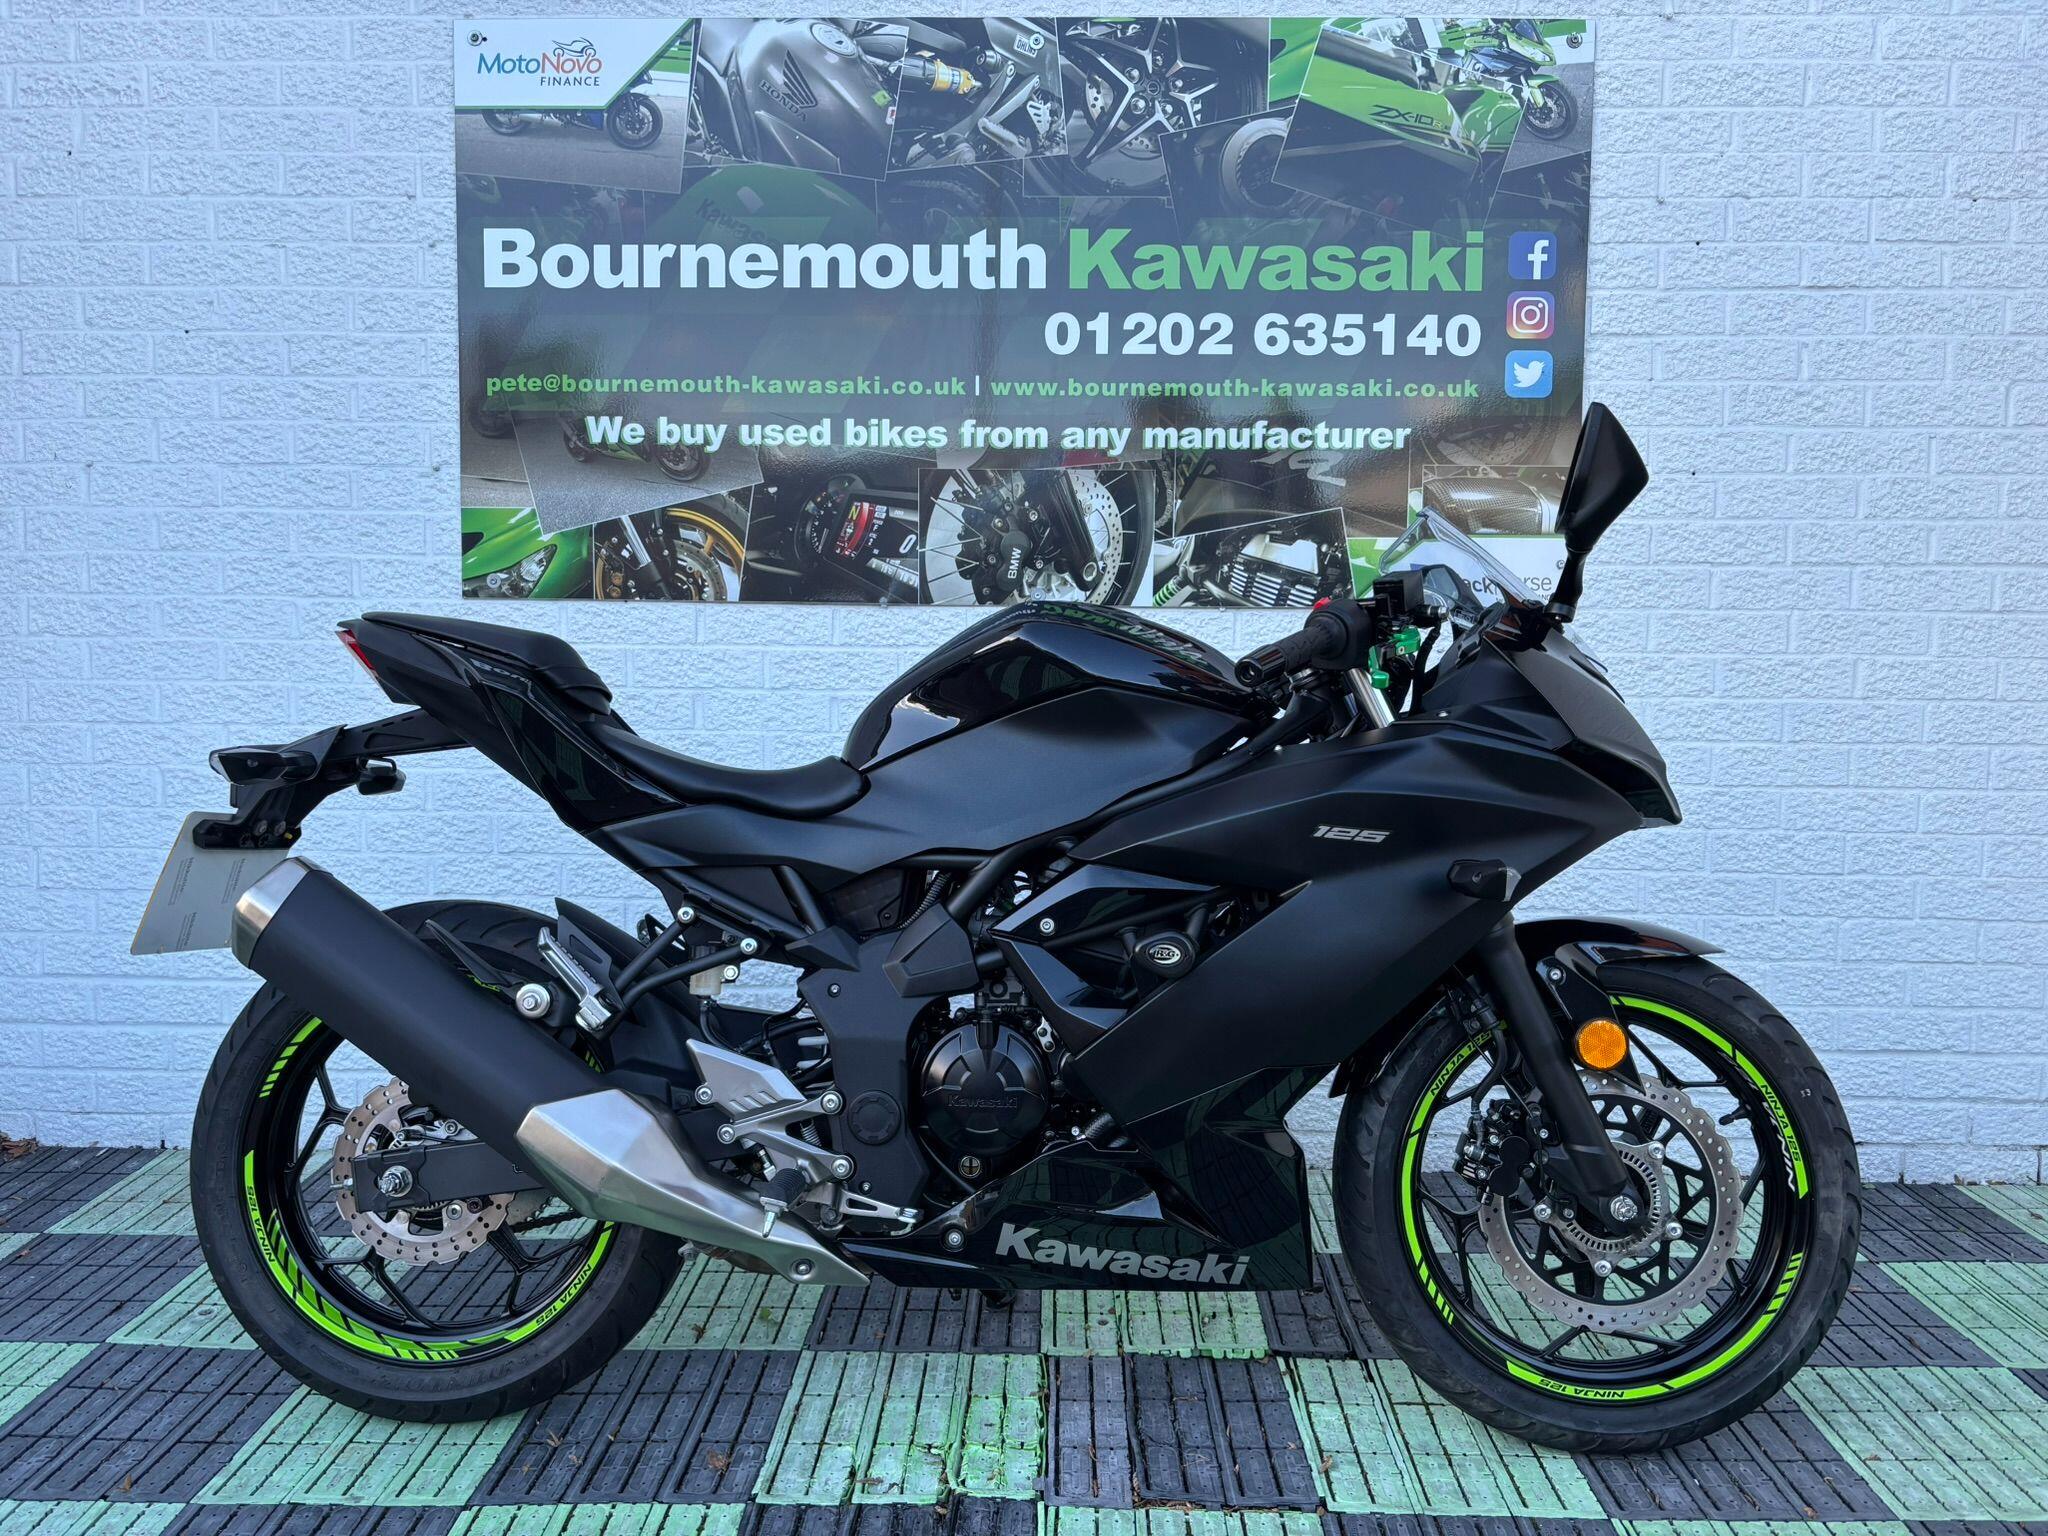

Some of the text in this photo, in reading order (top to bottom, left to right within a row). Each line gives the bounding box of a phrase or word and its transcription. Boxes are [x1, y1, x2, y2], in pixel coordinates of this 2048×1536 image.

[477, 52, 602, 74] MotoNovo
[540, 76, 600, 87] FINANCE
[760, 80, 808, 121] HONDA
[483, 227, 1484, 292] Bournemouth Kawasaki
[1044, 311, 1481, 357] 01202 635140
[486, 373, 967, 396] pete@bournemouth-kawasaki.co.uk
[990, 376, 1479, 398] www.bournemouth-kawasaki.co.uk
[584, 415, 1413, 457] We buy used bikes from any manufacturer
[1007, 547, 1022, 579] BMW
[1313, 825, 1391, 843] 125
[1430, 1053, 1465, 1097] NINJA
[1760, 1084, 1802, 1163] NINJA 125
[253, 1217, 277, 1263] NINJA
[994, 1222, 1251, 1286] Kawasaki
[560, 1263, 592, 1304] NINJA
[1574, 1387, 1626, 1399] NINJA
